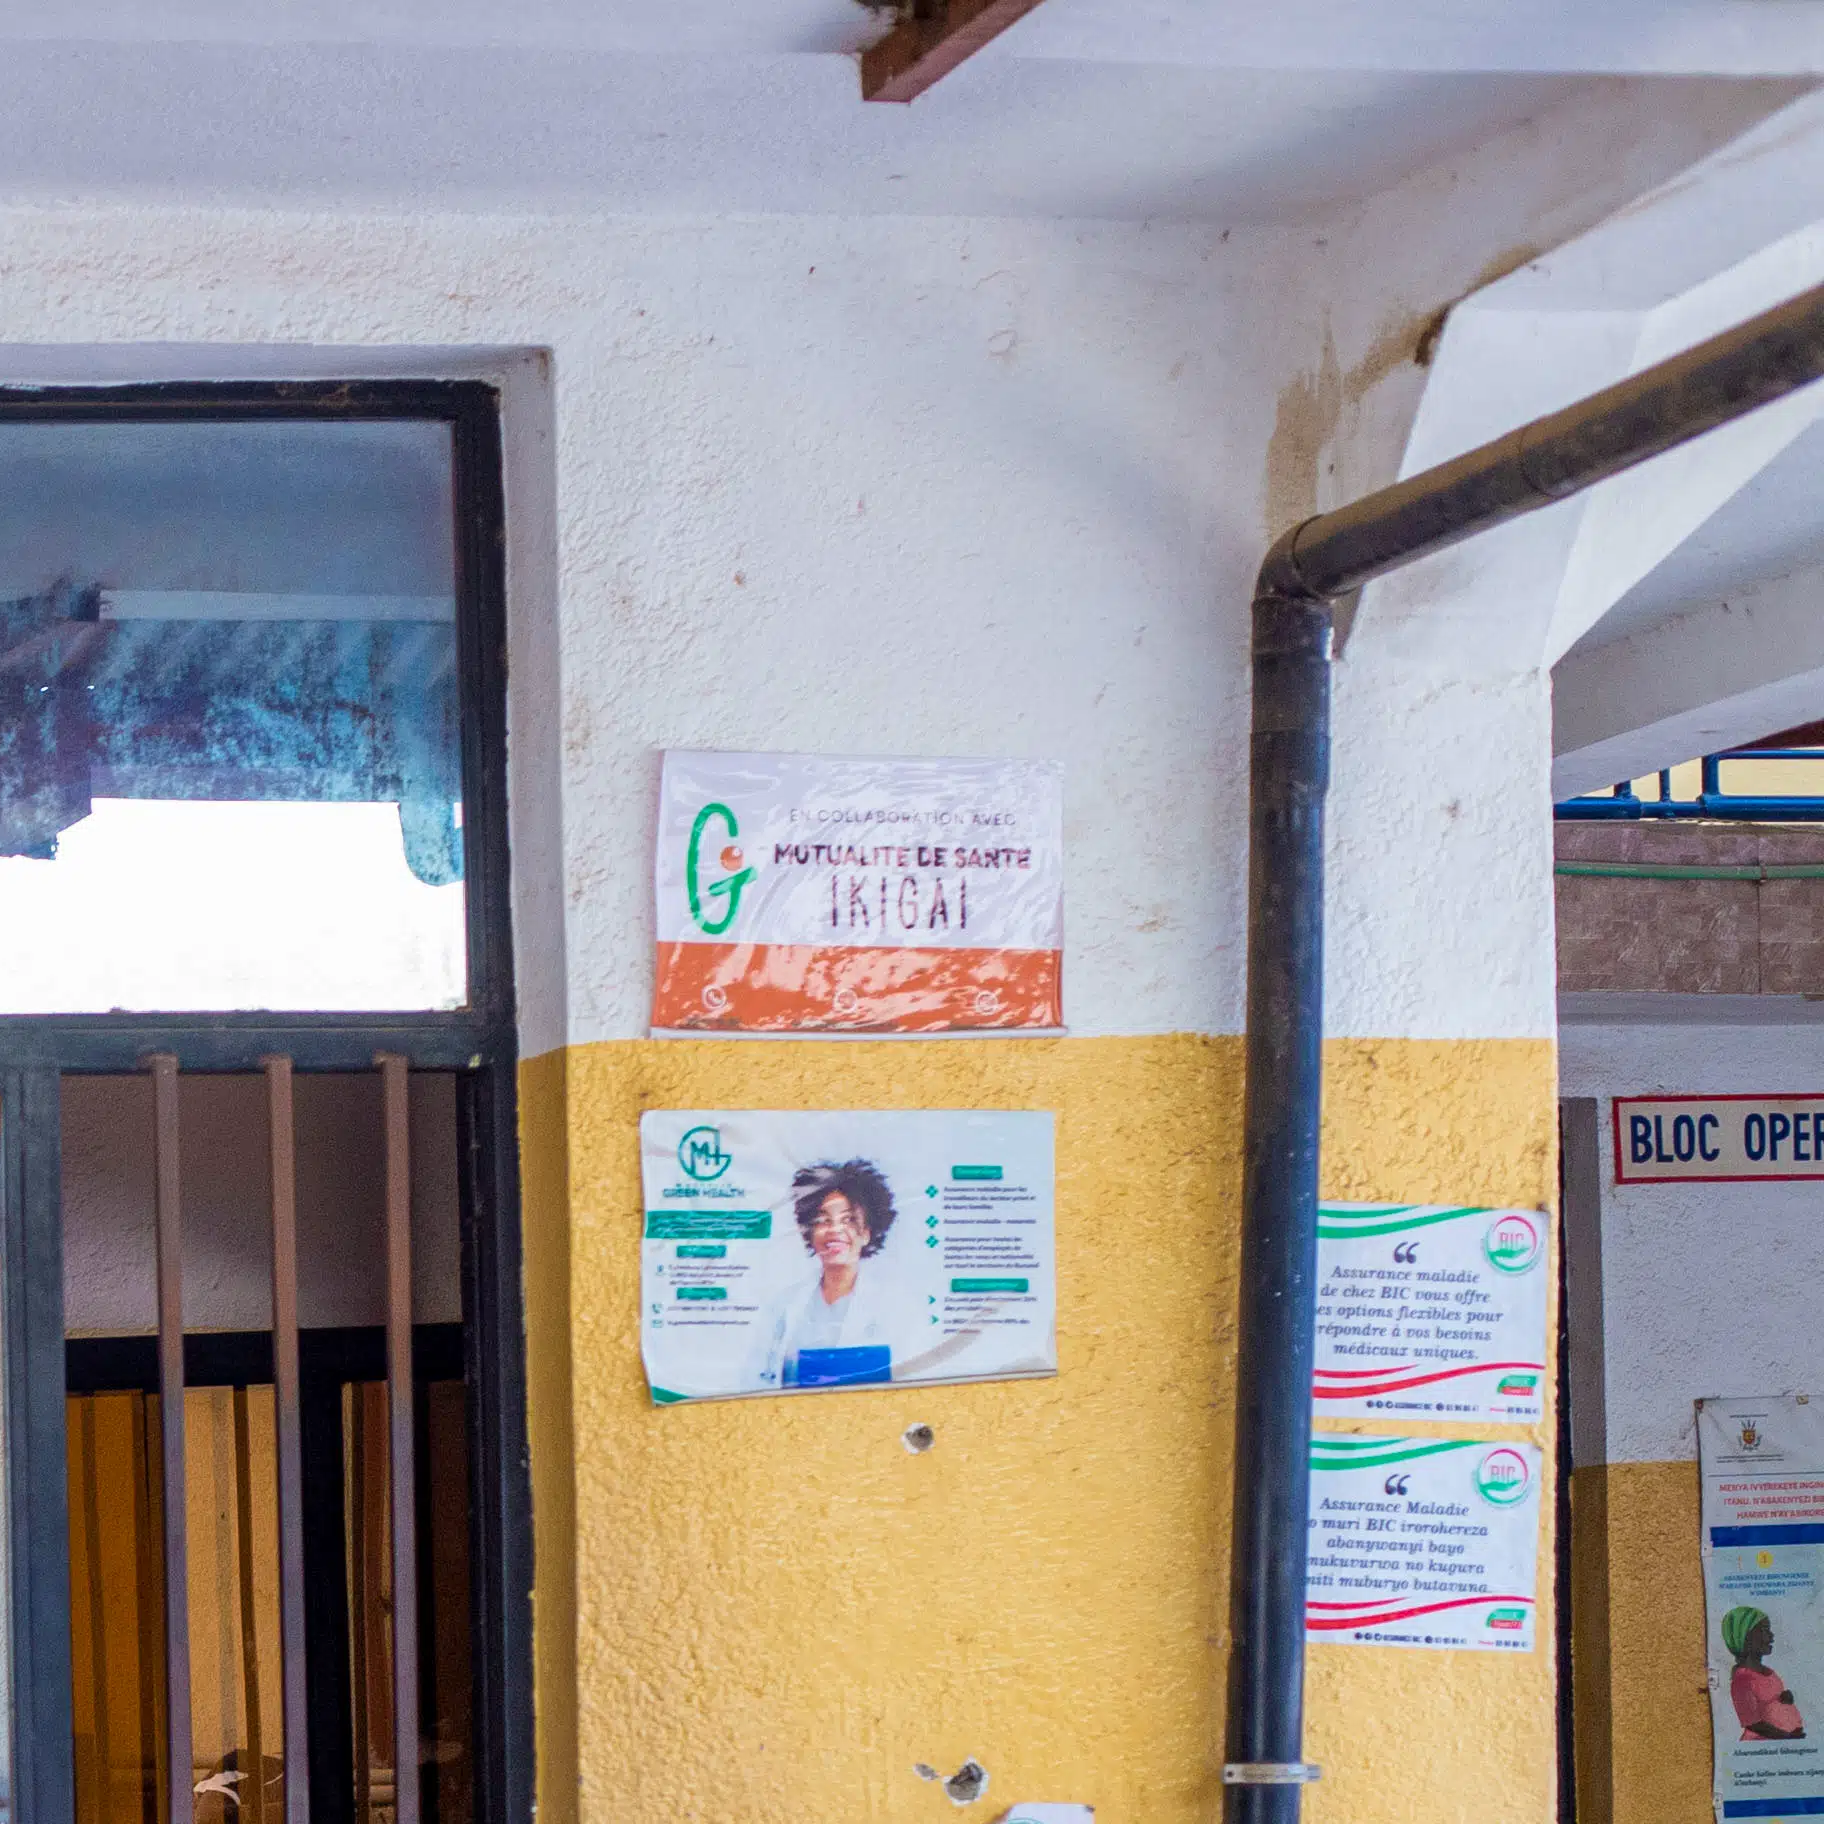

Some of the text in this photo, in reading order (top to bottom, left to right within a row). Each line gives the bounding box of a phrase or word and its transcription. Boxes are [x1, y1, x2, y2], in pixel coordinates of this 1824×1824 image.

[972, 812, 1017, 827] AVEC
[773, 843, 1033, 870] MUTUALITE DE SANTE
[830, 874, 968, 930] IKIGAI
[1630, 1113, 1721, 1164] BLOC
[1329, 1264, 1482, 1284] Assurance maladie
[1319, 1283, 1492, 1306] de chez BIC vous offre
[1336, 1304, 1394, 1321] options
[1395, 1305, 1462, 1322] flexibles
[1465, 1311, 1504, 1324] pour
[1316, 1322, 1493, 1341] répondre à vos besoins
[1333, 1342, 1480, 1361] médicaux uniques.
[1319, 1497, 1471, 1517] Assurance Maladie
[1322, 1517, 1361, 1531] muri
[1365, 1518, 1398, 1532] BIC
[1400, 1519, 1489, 1537] irorohereza
[1326, 1535, 1466, 1556] abanywanyi bayo
[1404, 1559, 1424, 1572] no
[1428, 1558, 1485, 1576] kugura
[1338, 1574, 1410, 1593] muburyo
